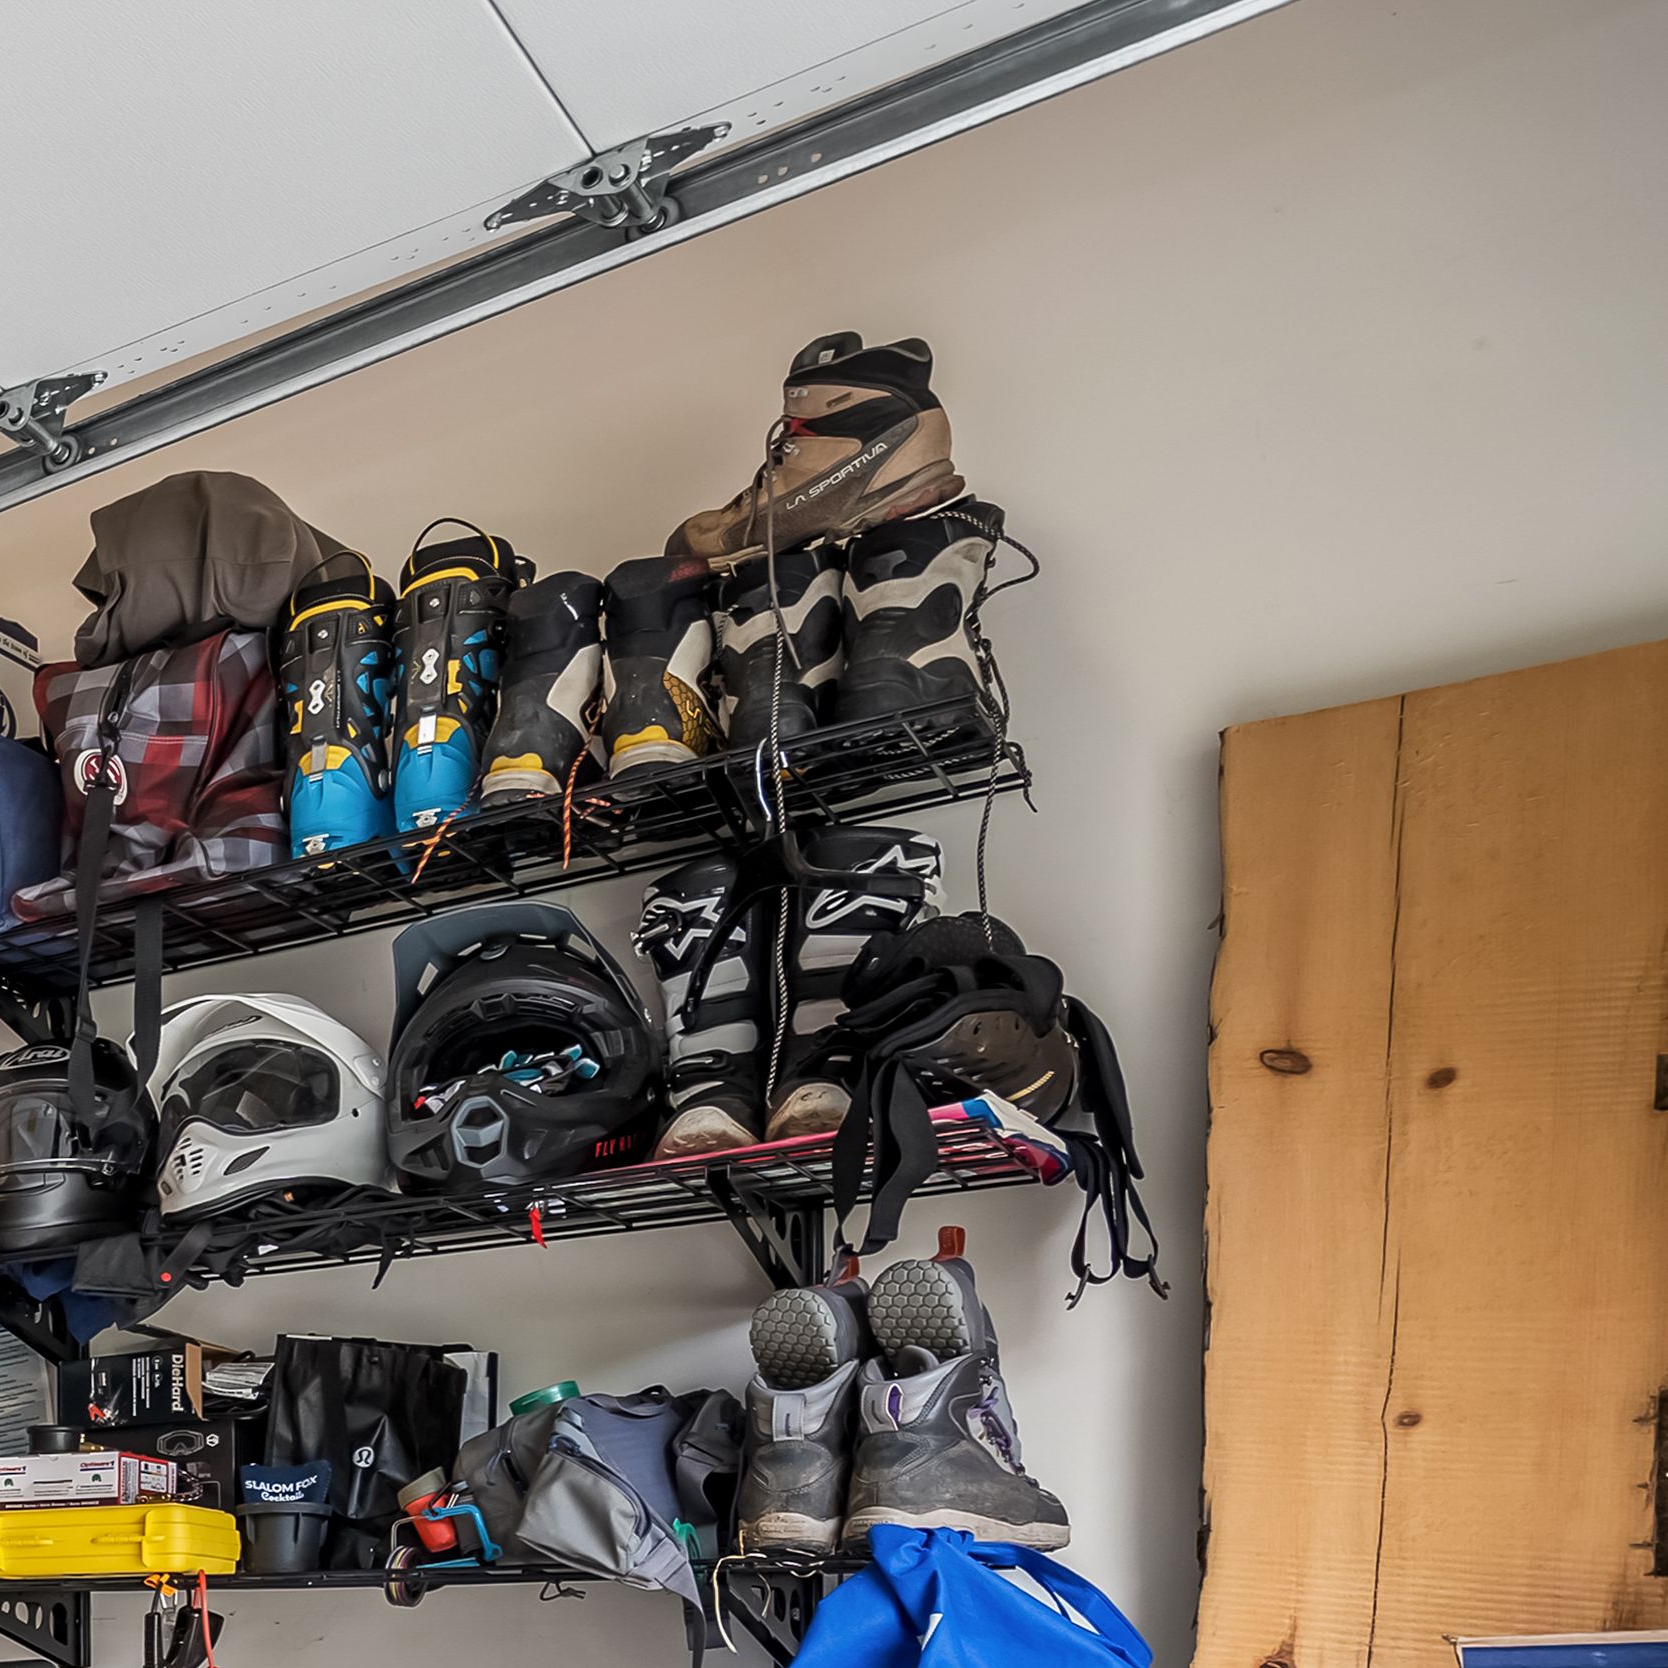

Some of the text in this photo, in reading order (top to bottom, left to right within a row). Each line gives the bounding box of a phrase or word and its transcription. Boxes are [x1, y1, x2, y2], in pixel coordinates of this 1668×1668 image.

[786, 442, 887, 510] LA SPORTIVA
[18, 1050, 63, 1062] Arai
[595, 1139, 616, 1157] FLY
[171, 1354, 185, 1413] DieHard
[245, 1474, 319, 1493] SLALOM FOX
[261, 1490, 305, 1503] Cocktails
